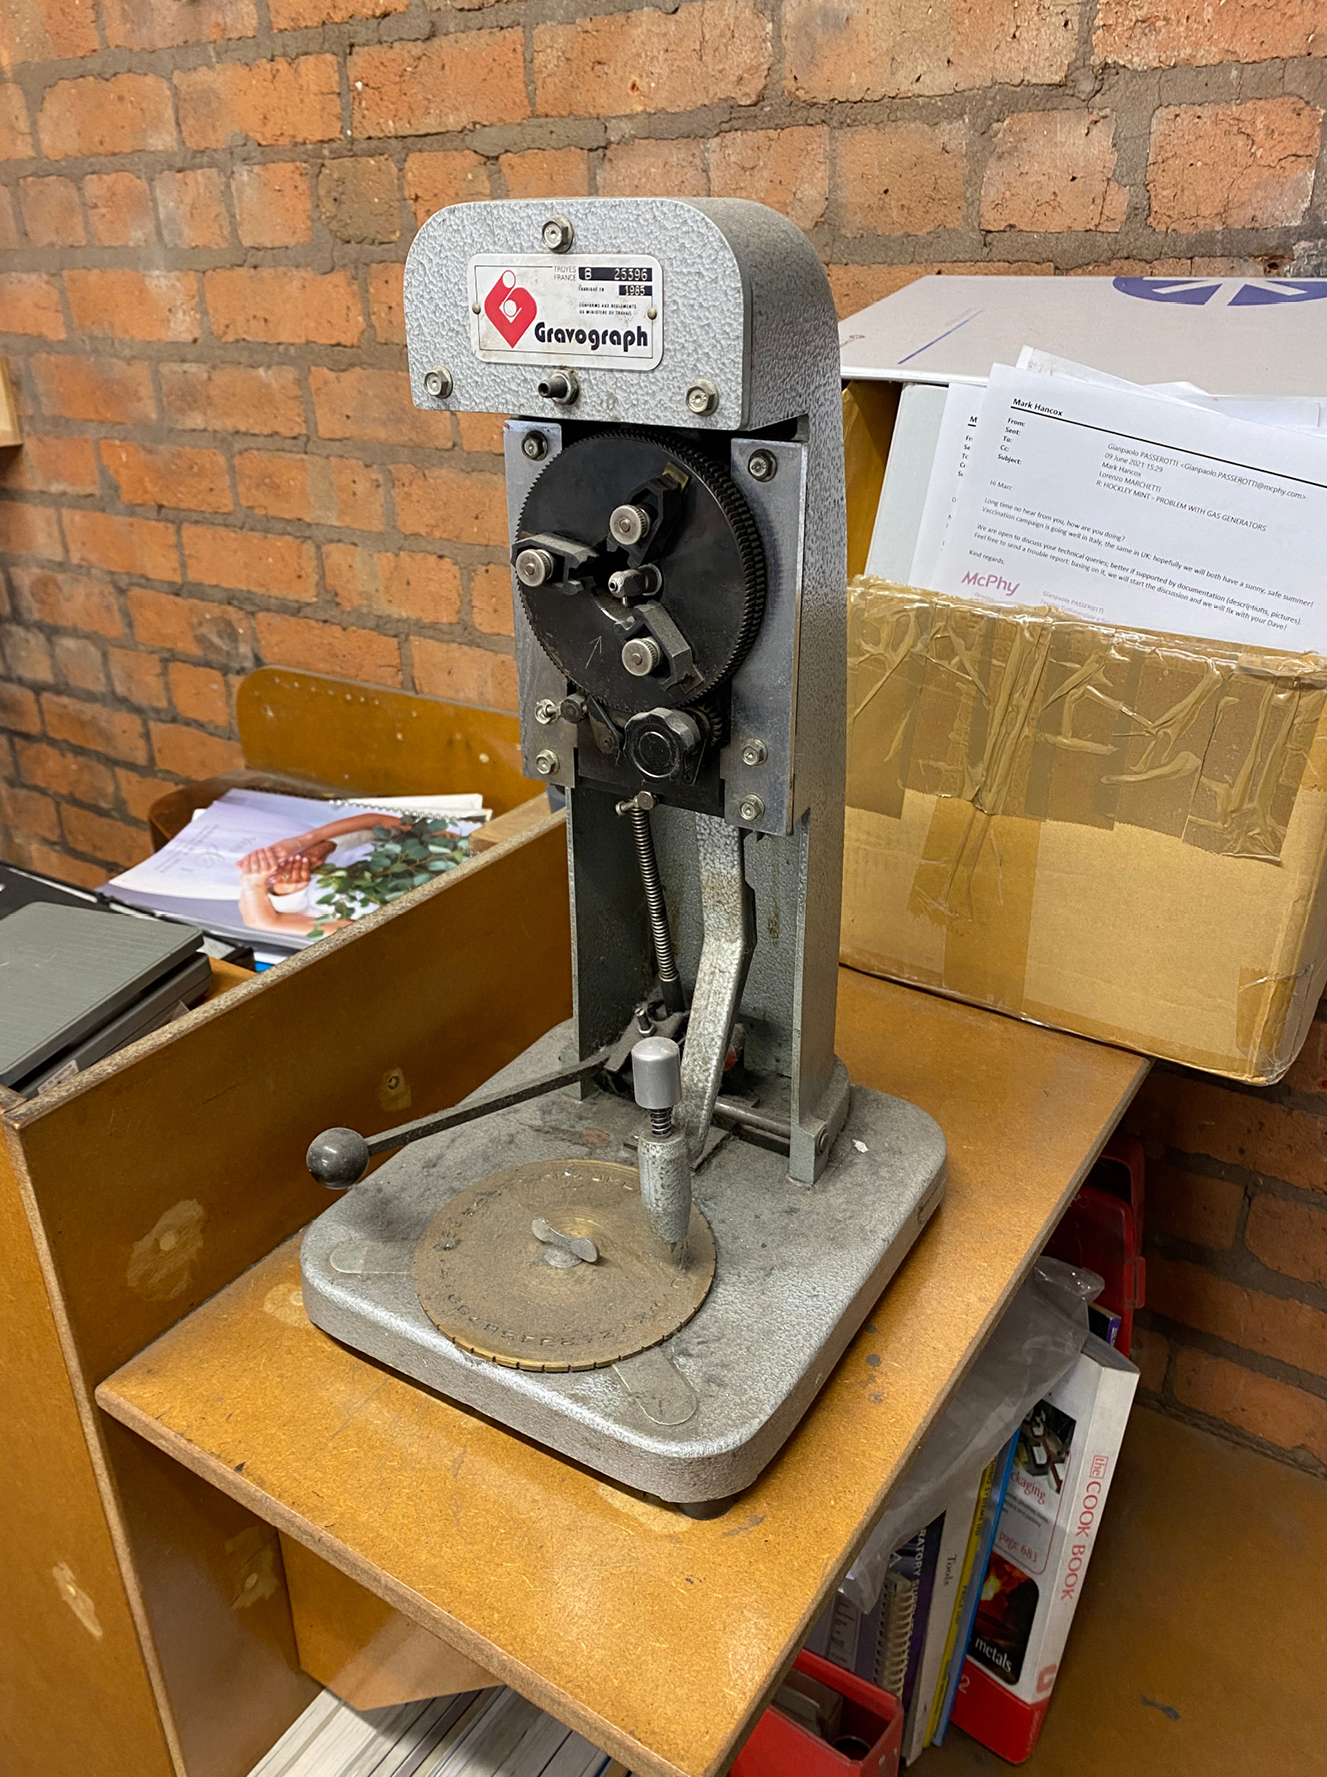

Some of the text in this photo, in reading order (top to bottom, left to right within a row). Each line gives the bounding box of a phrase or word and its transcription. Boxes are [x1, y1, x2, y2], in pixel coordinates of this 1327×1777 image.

[625, 285, 646, 296] 1985
[534, 321, 648, 352] Gravograph
[1012, 398, 1062, 416] Mark Hancox
[1005, 426, 1021, 436] Sent:
[1007, 417, 1026, 427] From:
[999, 444, 1010, 452] Cc:
[1002, 435, 1012, 443] To:
[997, 453, 1022, 465] Subject:
[1107, 442, 1139, 456] Gianpaolo
[1139, 450, 1179, 466] PASSEROTTI
[1113, 454, 1128, 463] June
[1128, 458, 1144, 468] 2021
[1146, 462, 1163, 472] 15:29
[1101, 461, 1141, 477] Mark Hancox
[996, 481, 1012, 490] Marc
[1098, 470, 1161, 492] Lorenzo MARCHETTI
[1102, 481, 1133, 494] HOCKLEY
[1132, 489, 1151, 499] MINT
[1155, 495, 1187, 509] PROBLEM
[1188, 504, 1205, 514] WITH
[1206, 509, 1221, 519] GAS
[1221, 514, 1266, 531] GENERATORS
[984, 497, 998, 507] Long
[999, 501, 1013, 510] time
[1022, 507, 1036, 516] hear
[1036, 511, 1052, 521] from
[1052, 517, 1065, 525] you,
[1066, 520, 1080, 528] how
[1103, 531, 1125, 542] doing?
[968, 549, 982, 557] Kind
[982, 506, 1015, 520] Vaccination
[1015, 516, 1044, 528] campaign
[1049, 526, 1067, 536] going
[1081, 533, 1087, 541] in
[1088, 536, 1102, 546] Italy,
[1104, 541, 1115, 549] the
[1115, 545, 1132, 554] same
[1152, 554, 1182, 569] hopefully
[1205, 570, 1221, 580] both
[1221, 575, 1238, 585] have
[1244, 583, 1266, 594] sunny,
[1267, 589, 1282, 598] safe
[997, 530, 1013, 538] open
[1021, 536, 1042, 547] discuss
[1057, 546, 1085, 559] technical
[1109, 561, 1129, 572] better
[1135, 570, 1168, 584] supported
[1167, 579, 1176, 588] by
[1176, 582, 1225, 602] documentation
[961, 570, 1021, 597] McPhy
[973, 531, 986, 540] Feel
[986, 535, 998, 543] free
[1007, 542, 1021, 550] send
[1026, 547, 1048, 558] trouble
[1070, 560, 1090, 572] basing
[1129, 578, 1144, 587] start
[1144, 582, 1156, 590] the
[1156, 585, 1188, 600] discussion
[1188, 596, 1202, 604] and
[1202, 600, 1212, 608] we
[1225, 606, 1234, 614] fix
[1234, 610, 1249, 619] with
[1250, 615, 1266, 624] your
[1266, 619, 1287, 630] Dave!
[1061, 1458, 1105, 1601] the COOK BOOK
[1000, 1531, 1038, 1564] page 683
[944, 1552, 958, 1587] Tools
[975, 1637, 1013, 1673] metals
